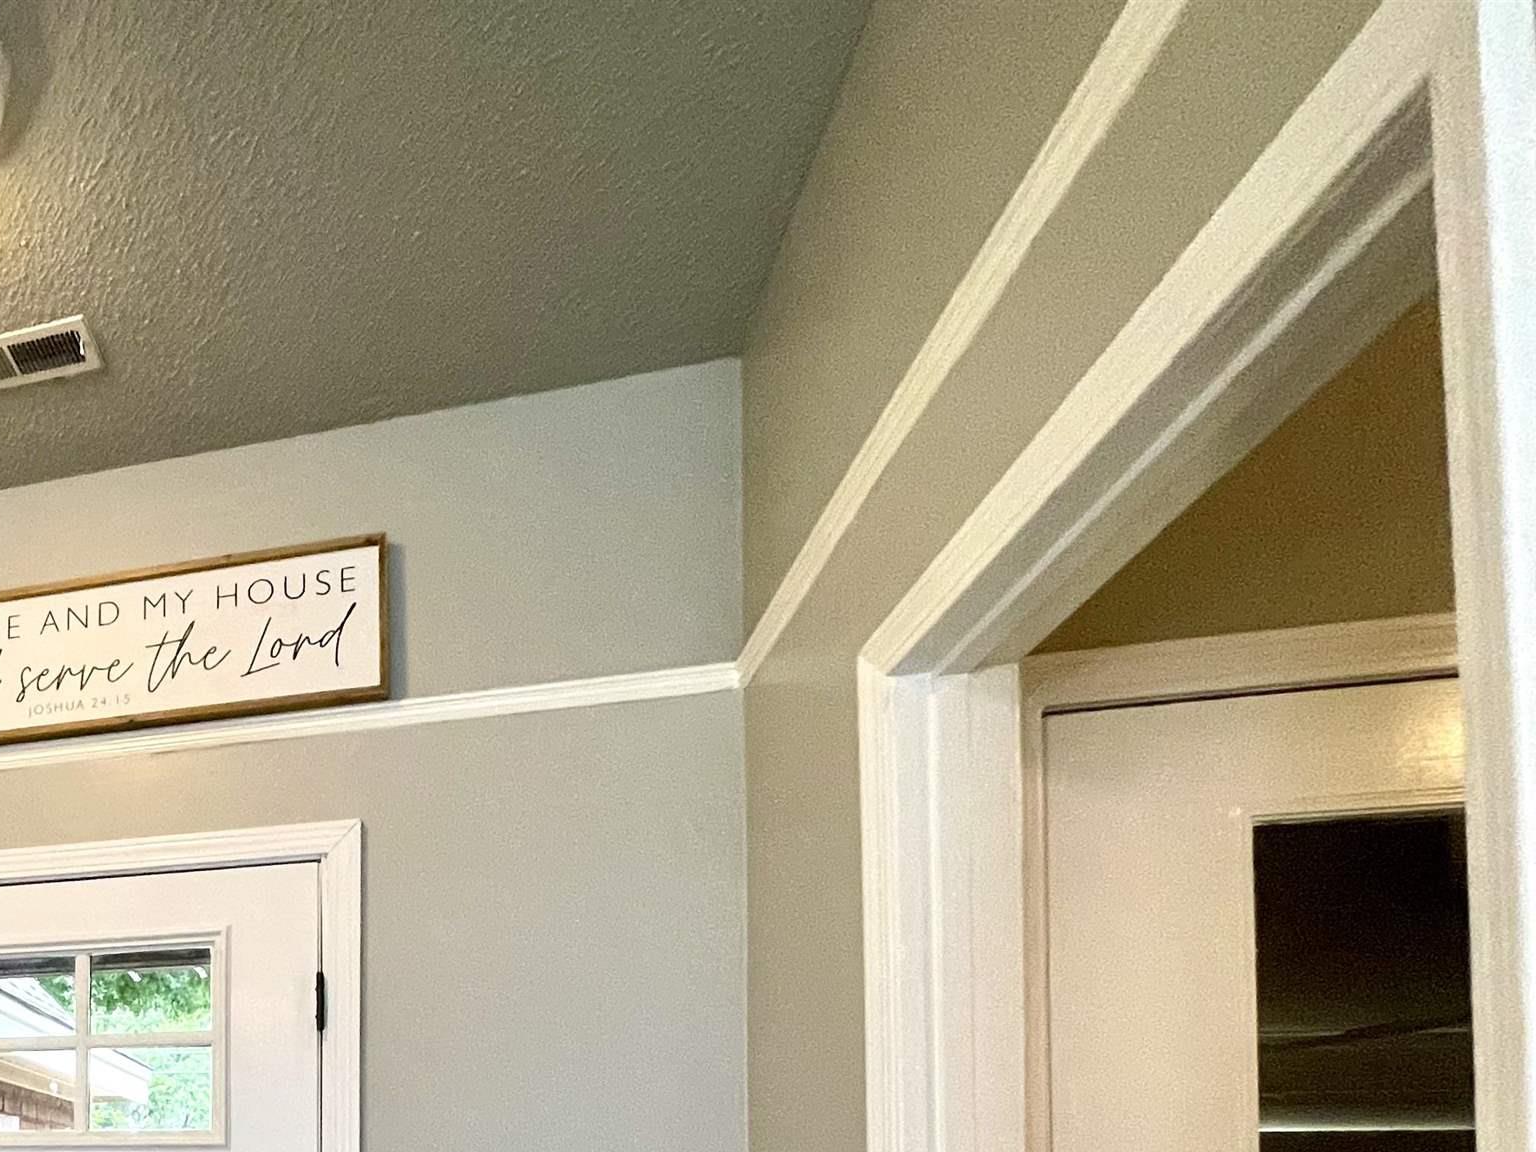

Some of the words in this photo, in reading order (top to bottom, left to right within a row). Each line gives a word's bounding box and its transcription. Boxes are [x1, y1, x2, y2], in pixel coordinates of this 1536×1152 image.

[39, 600, 121, 636] AND
[143, 588, 194, 621] MY
[216, 565, 357, 611] HOUSE
[16, 656, 134, 704] serve
[144, 620, 232, 693] the
[240, 601, 357, 677] Lord
[28, 699, 84, 718] JOSHUA
